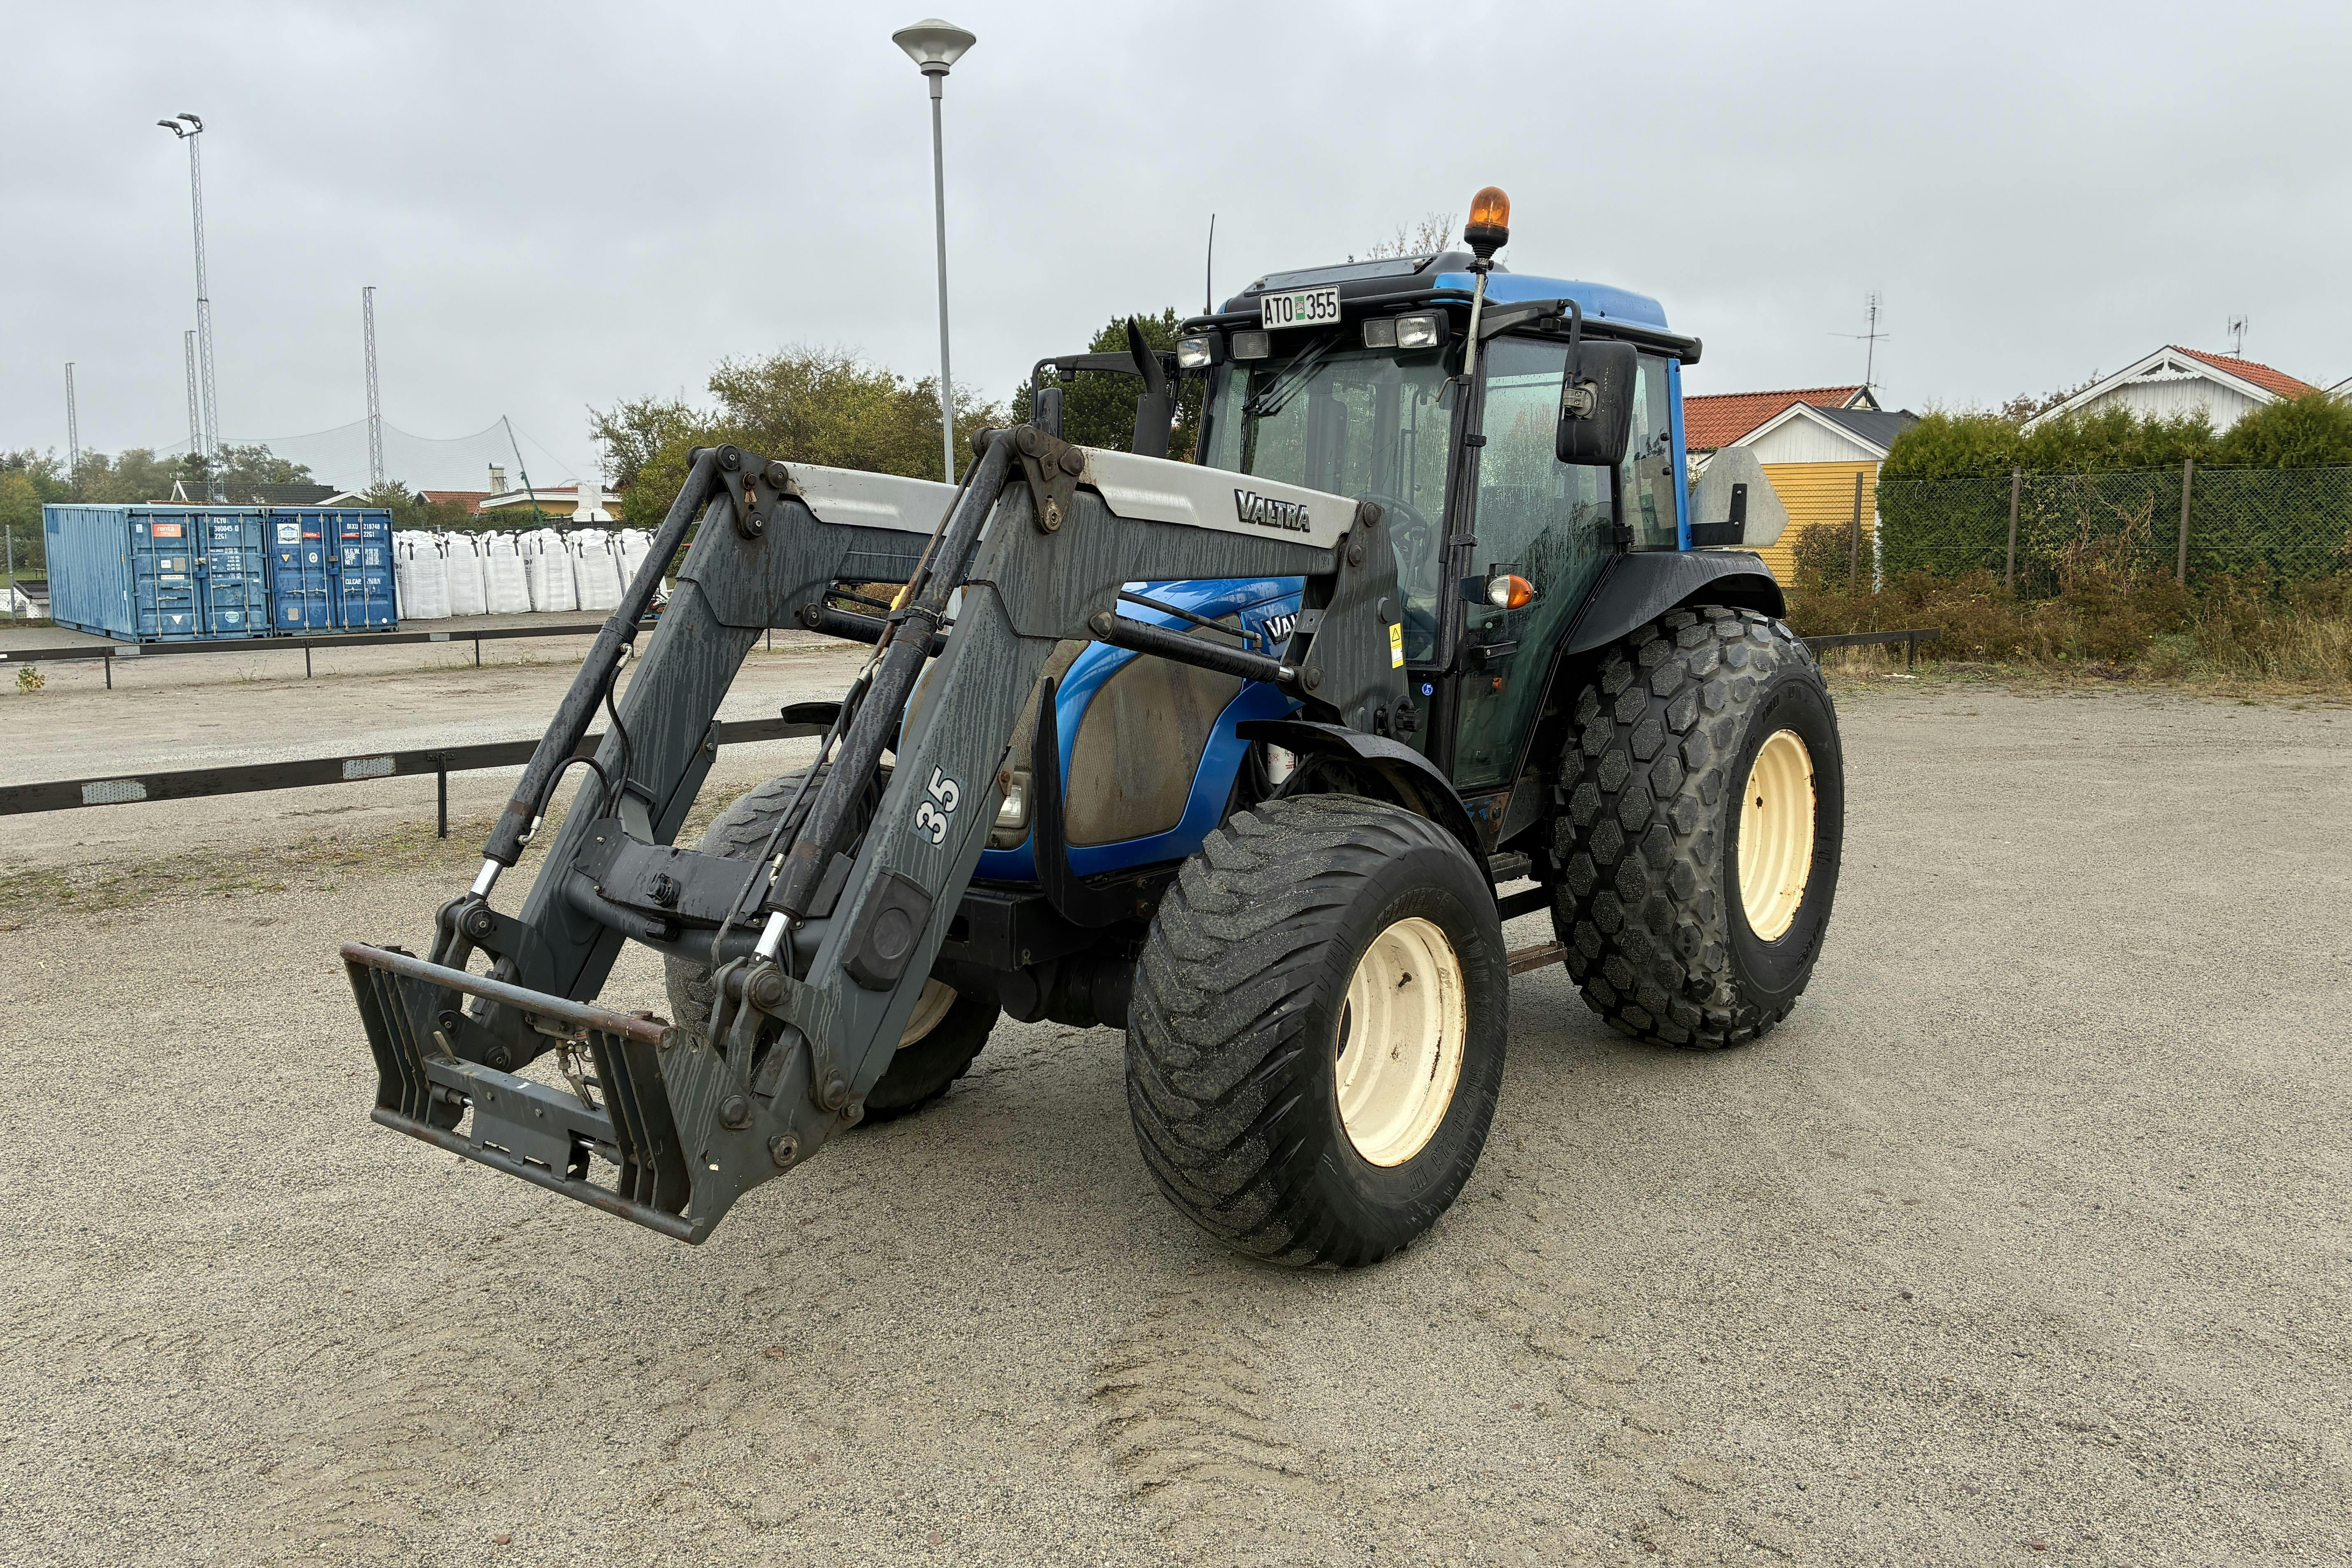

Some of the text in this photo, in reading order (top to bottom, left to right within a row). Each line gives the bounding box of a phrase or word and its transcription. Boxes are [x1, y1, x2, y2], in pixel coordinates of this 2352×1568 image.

[1265, 291, 1337, 324] ATO 355
[1234, 488, 1311, 532] VALTRA
[915, 764, 961, 845] 35
[1461, 927, 1491, 983] TWIN
